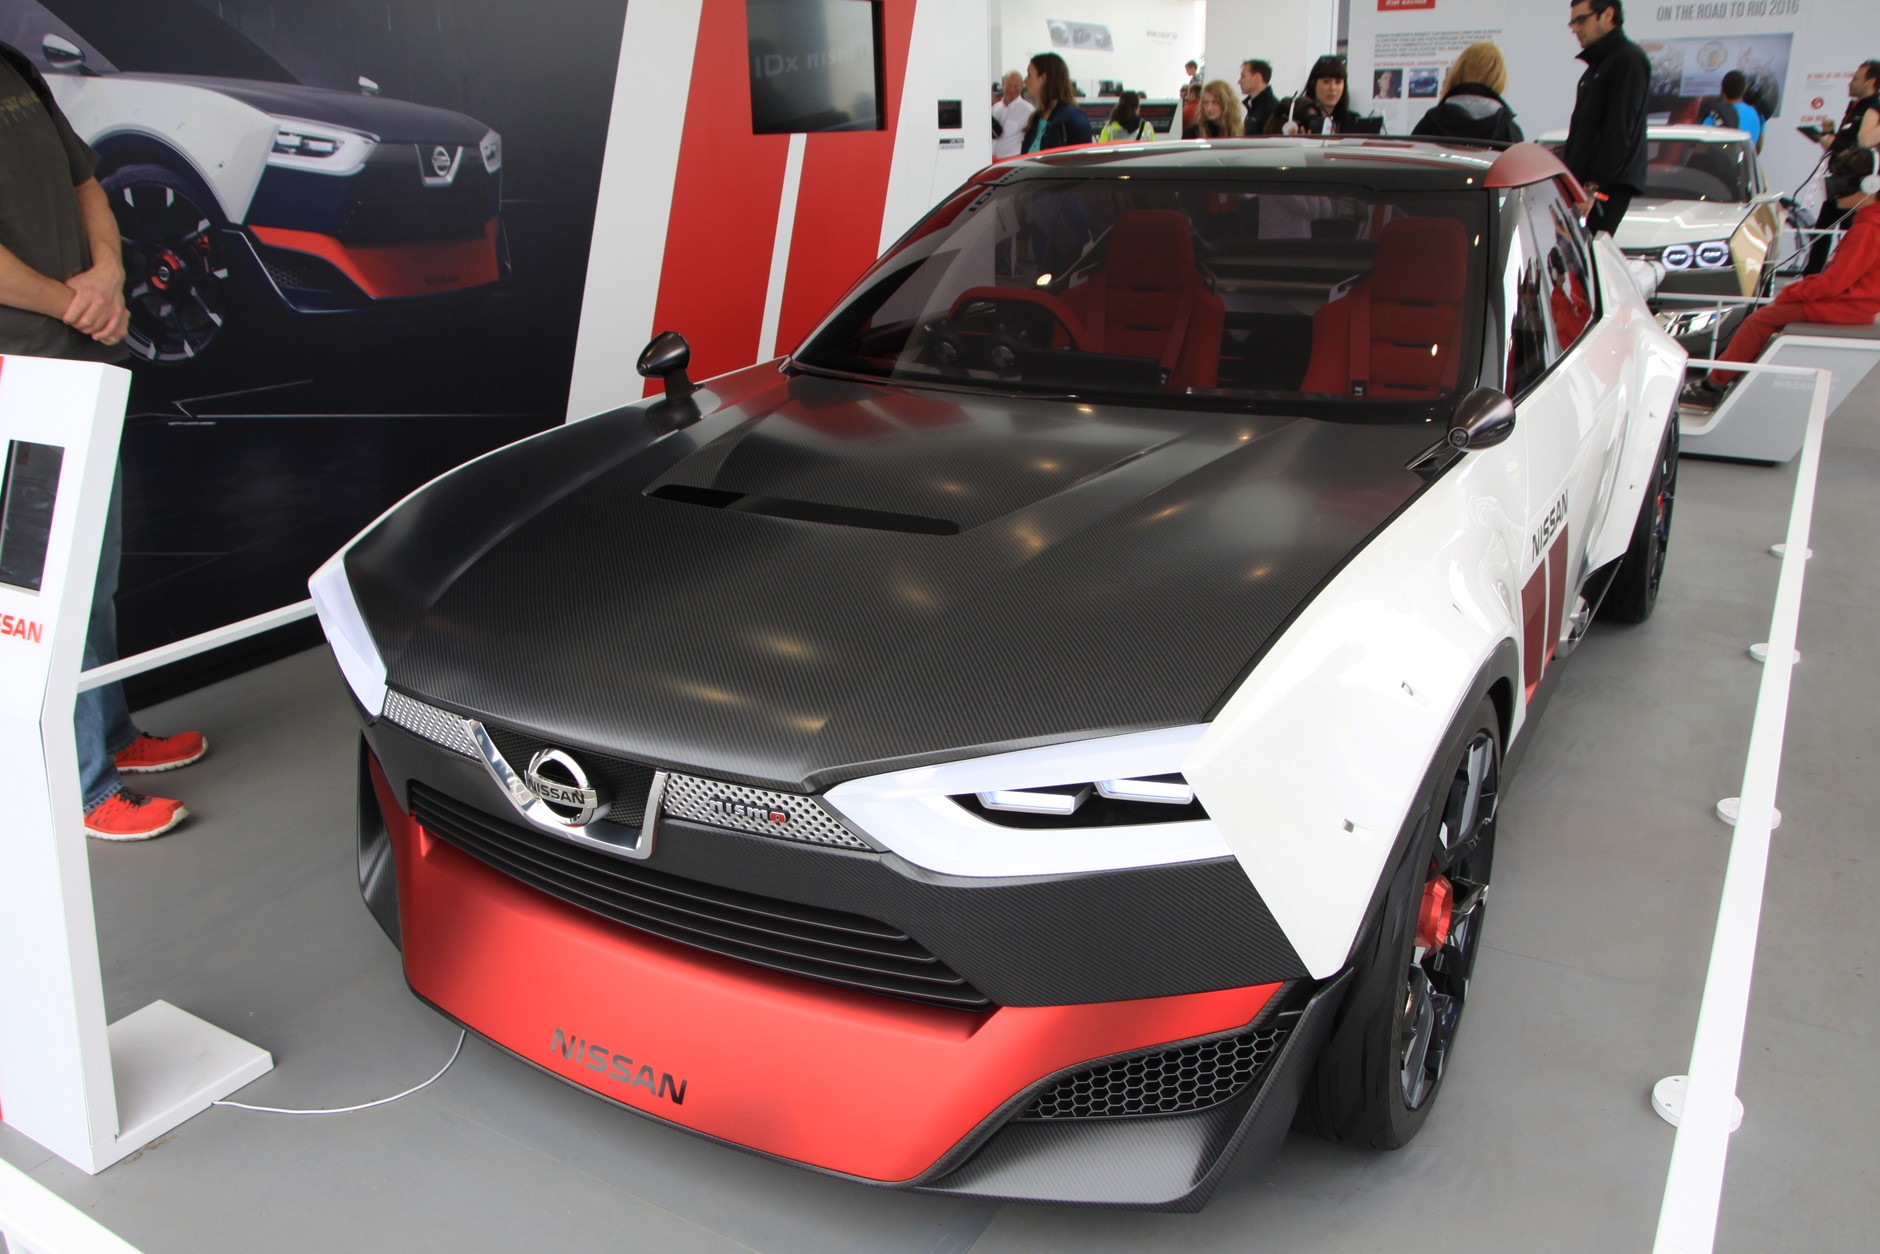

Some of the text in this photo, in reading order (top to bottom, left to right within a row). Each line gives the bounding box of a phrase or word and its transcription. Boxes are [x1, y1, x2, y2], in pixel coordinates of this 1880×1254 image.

[1656, 0, 1800, 22] ON THE ROAD TO RIO 2016
[1532, 488, 1569, 563] NISSAN
[0, 613, 43, 643] SAN
[528, 779, 585, 805] NISSAN
[709, 800, 787, 823] nismo
[551, 1028, 687, 1105] NISSAN
